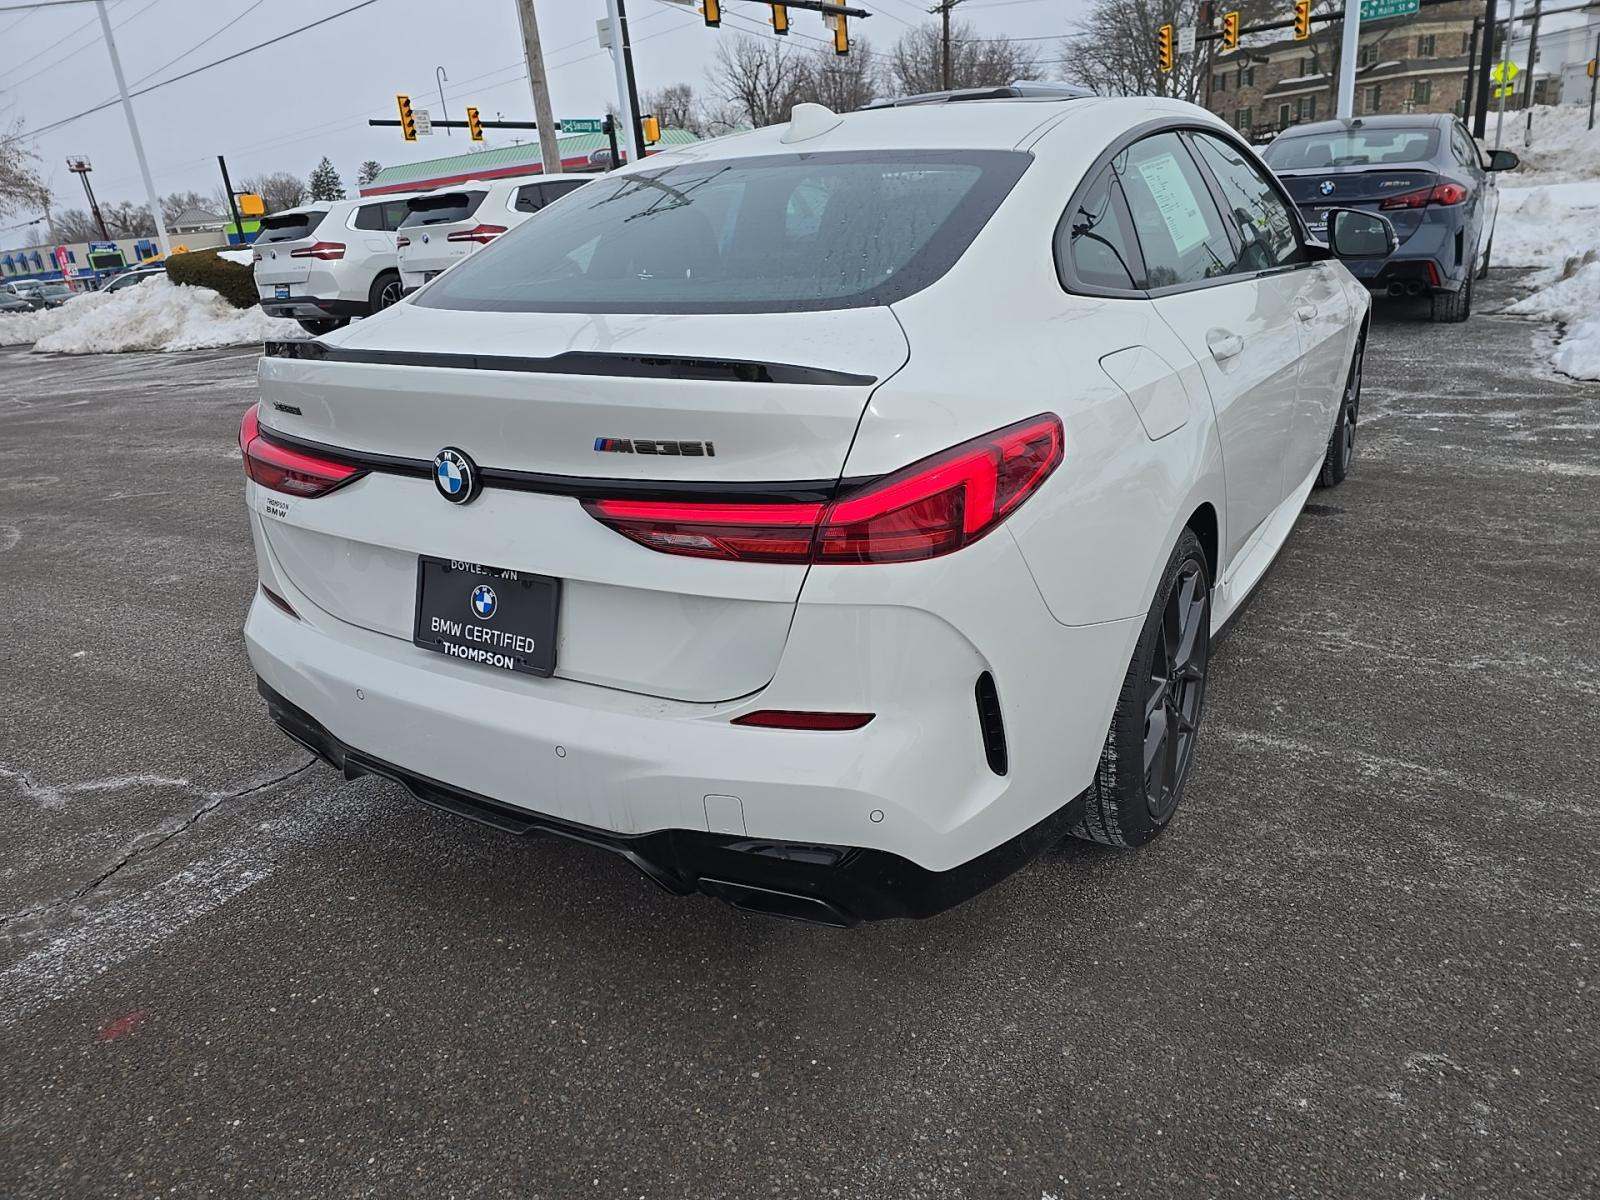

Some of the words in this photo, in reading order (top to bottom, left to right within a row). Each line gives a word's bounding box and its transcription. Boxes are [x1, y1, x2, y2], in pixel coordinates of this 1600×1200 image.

[573, 121, 592, 131] Swamp
[266, 506, 287, 518] BMW
[450, 559, 518, 581] DOYLEWN
[431, 616, 462, 638] BMW
[465, 624, 535, 654] CERTIFIED
[443, 641, 514, 670] THOMPSON
